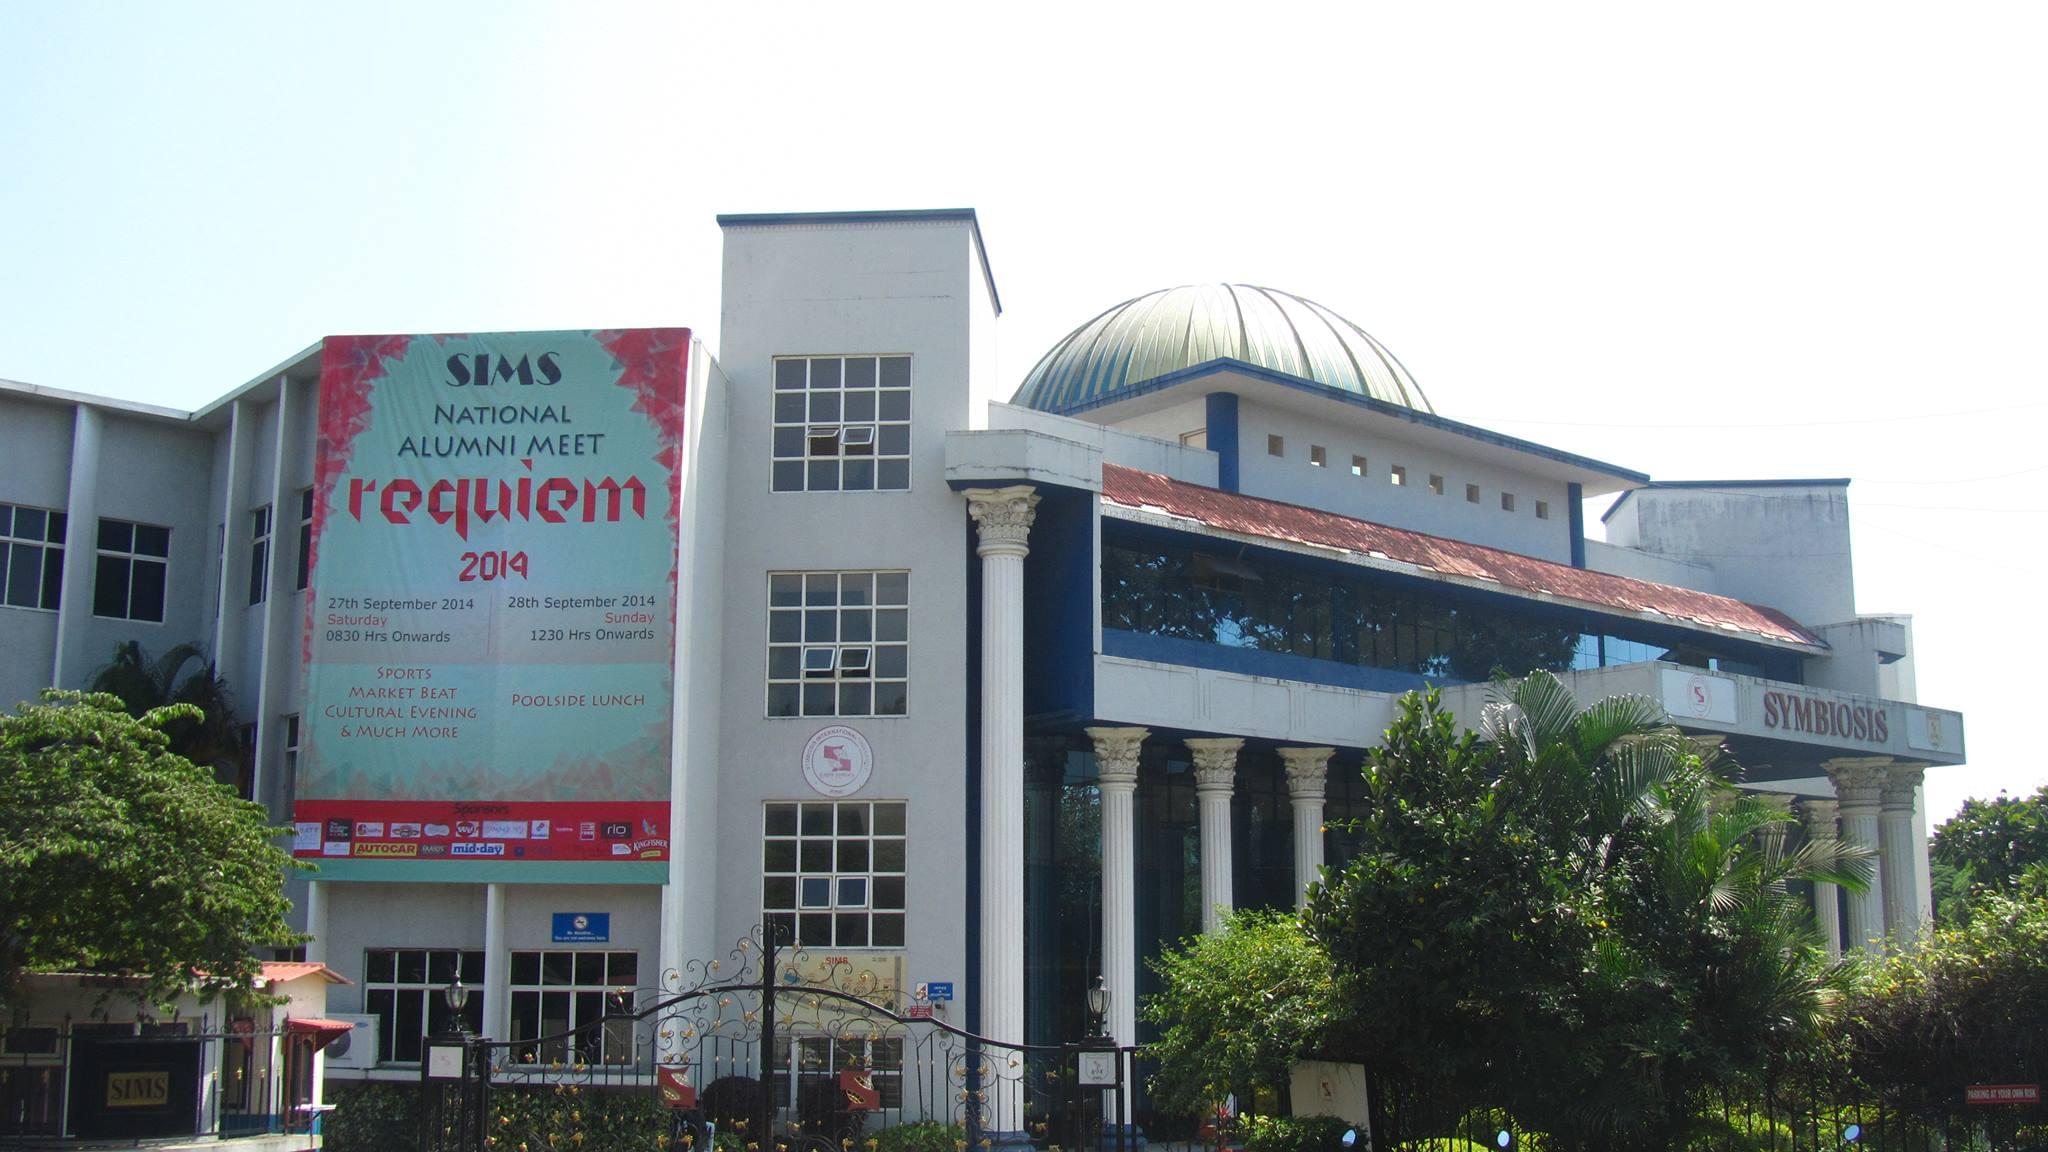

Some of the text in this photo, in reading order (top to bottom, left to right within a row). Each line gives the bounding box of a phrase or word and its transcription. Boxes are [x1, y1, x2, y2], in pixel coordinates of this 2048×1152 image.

[445, 351, 562, 387] SIMS
[434, 403, 572, 425] NATIONAL
[398, 433, 605, 457] ALUMNI MEET
[348, 459, 646, 543] requiem
[458, 550, 528, 582] 2014
[328, 597, 474, 612] 27th September 2014
[508, 595, 655, 612] 28th September 2014
[327, 614, 388, 627] Saturday
[605, 611, 655, 625] Sunday
[326, 631, 450, 642] 0830 Hrs Onwards
[531, 628, 654, 641] 1230 Hrs Onwards
[376, 666, 432, 680] SPORTS
[348, 686, 457, 699] MARKET BEAT
[512, 694, 645, 707] POOLSIDE LUNCH
[325, 705, 477, 719] CULTURAL EVENING
[1764, 691, 1889, 743] SYMBIOSIS
[340, 726, 458, 738] & MUCH MORE
[356, 843, 416, 855] AUTOCAR
[633, 839, 668, 852] KINGFISHER
[825, 956, 849, 965] SIMS
[112, 1077, 166, 1100] SIMS
